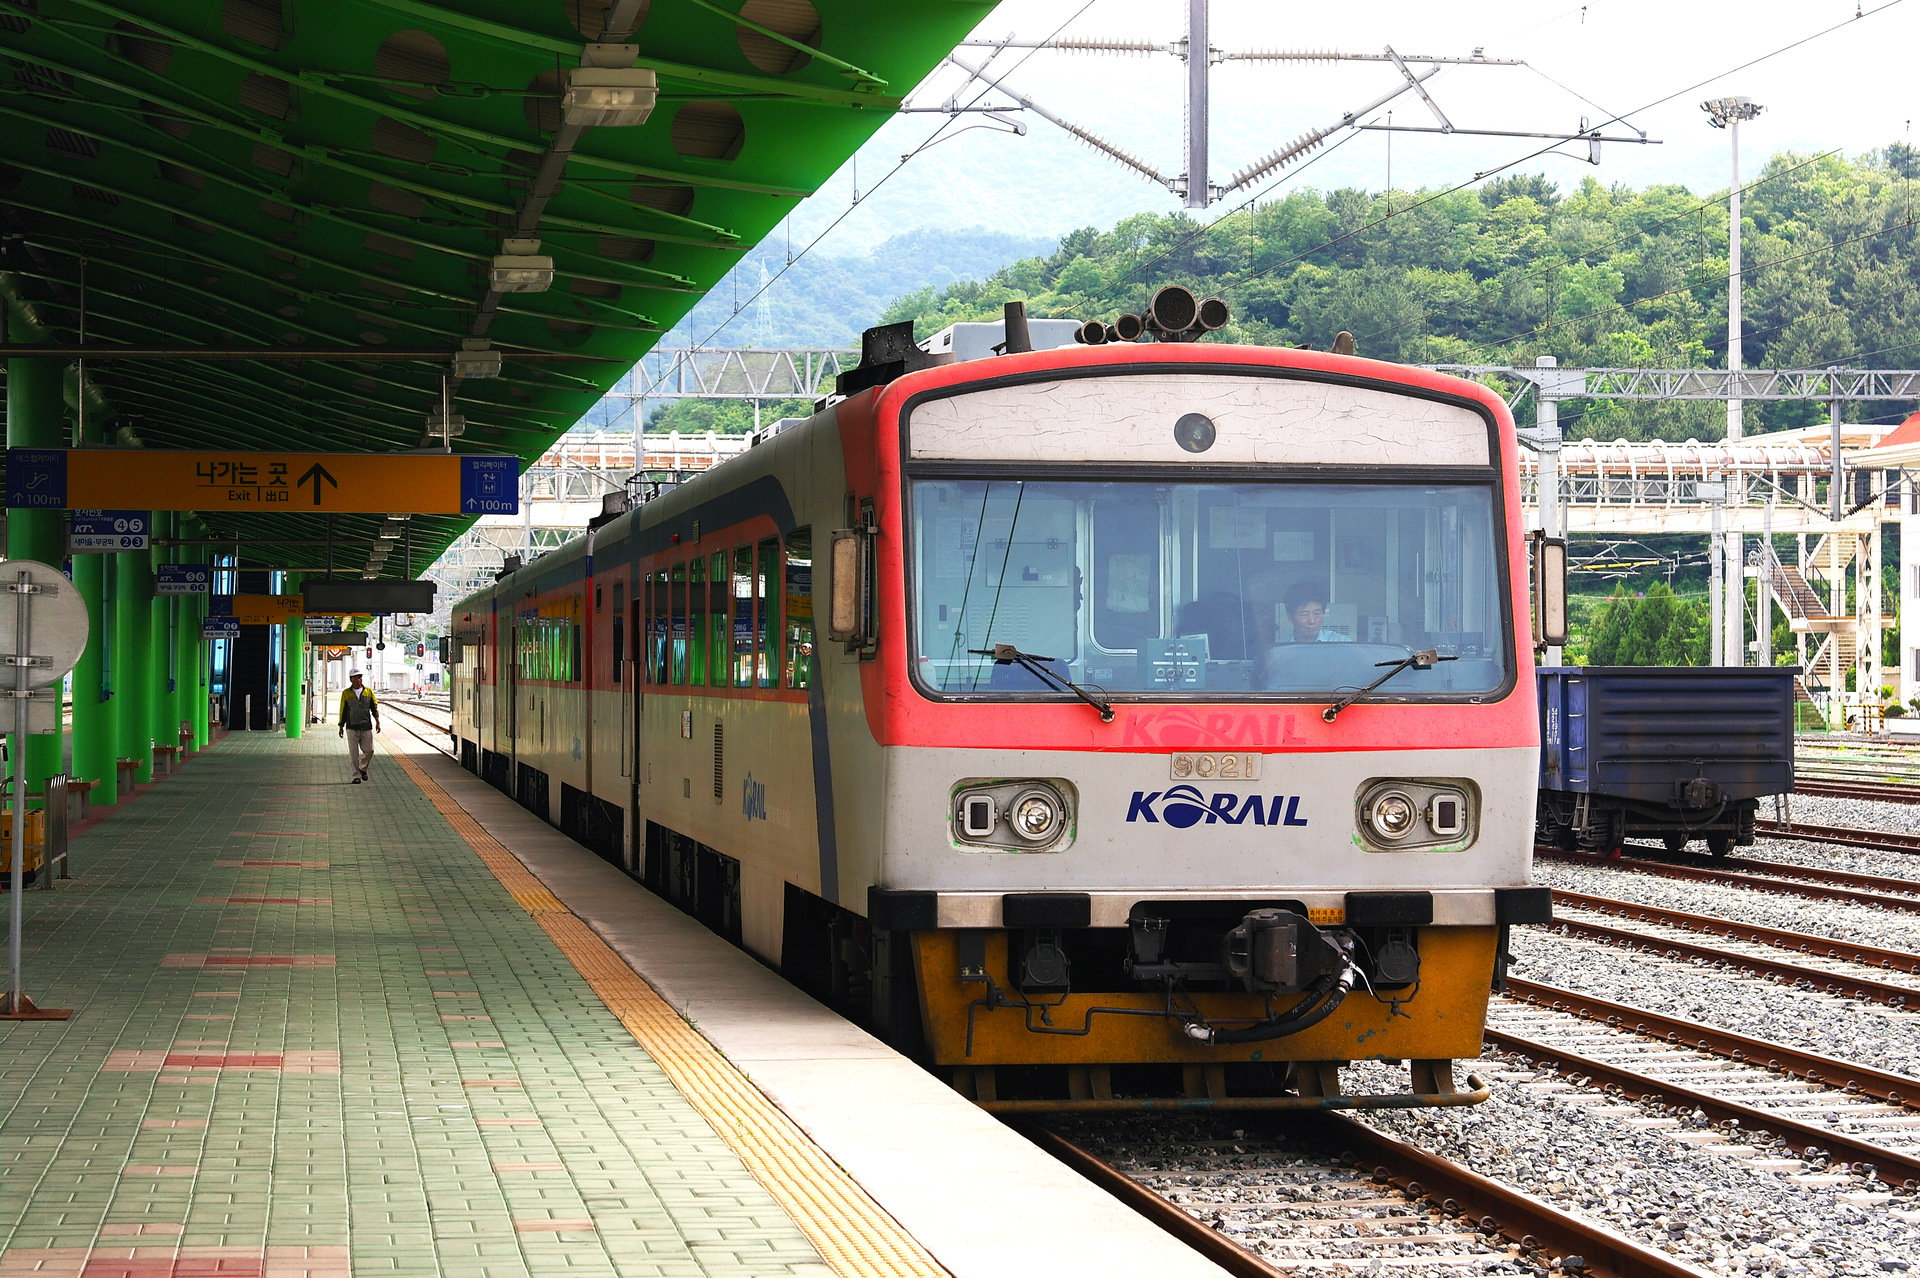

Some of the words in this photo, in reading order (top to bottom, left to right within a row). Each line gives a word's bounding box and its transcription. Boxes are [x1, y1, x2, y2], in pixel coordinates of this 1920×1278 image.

[196, 462, 258, 484] 나가는
[268, 462, 288, 485] 곳
[472, 461, 507, 470] 엘리베이터
[228, 490, 251, 501] Exit
[265, 490, 289, 502] 出口
[1124, 706, 1307, 746] KORAIL
[1173, 754, 1253, 778] 9021
[743, 771, 766, 823] KORAIL
[1126, 784, 1308, 828] KORAIL
